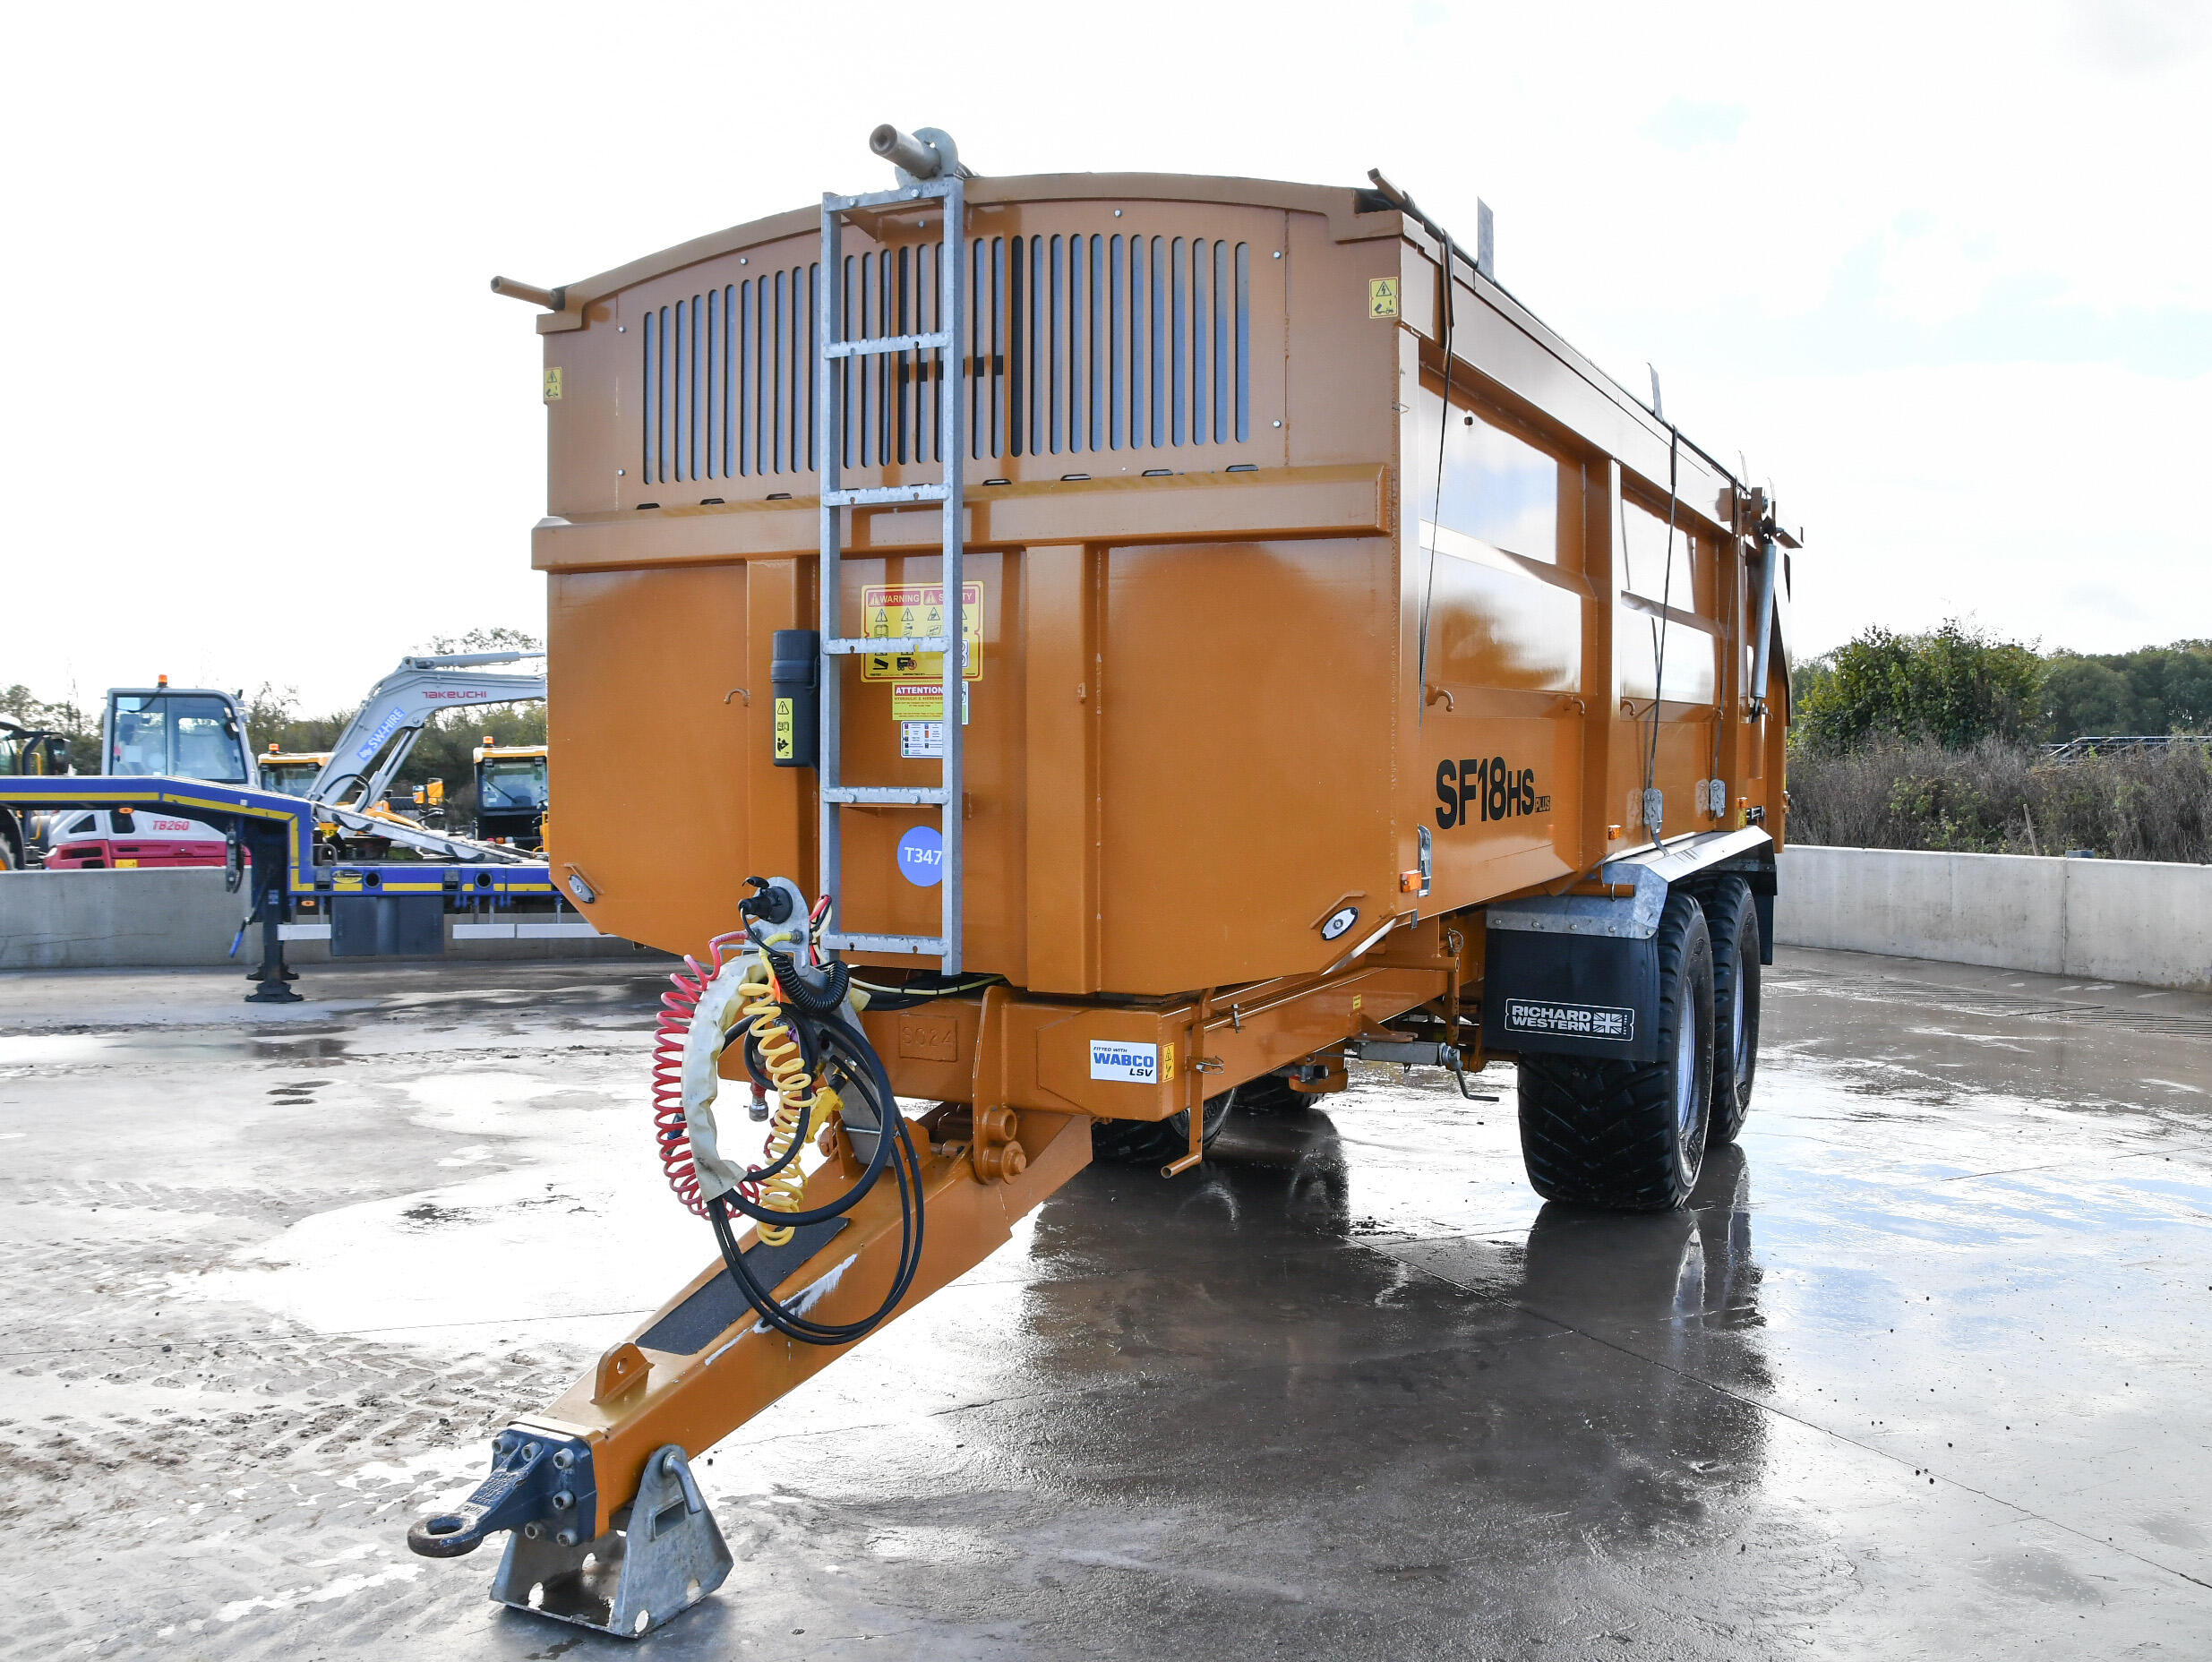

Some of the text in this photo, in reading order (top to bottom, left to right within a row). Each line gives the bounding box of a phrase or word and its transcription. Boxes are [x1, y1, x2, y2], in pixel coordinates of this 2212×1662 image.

[879, 594, 920, 604] WARNING
[422, 690, 487, 698] TAKEUCHI
[896, 686, 943, 695] ATTENTION
[368, 708, 404, 749] SW-HIRE
[1436, 757, 1534, 829] SF18HS
[1536, 796, 1550, 811] PLUS
[152, 820, 190, 831] TB260
[904, 846, 943, 866] T347
[1512, 1005, 1591, 1022] RICHARD
[1512, 1015, 1590, 1032] WESTERN
[1093, 1052, 1154, 1067] WABCO
[1129, 1068, 1153, 1077] LSV
